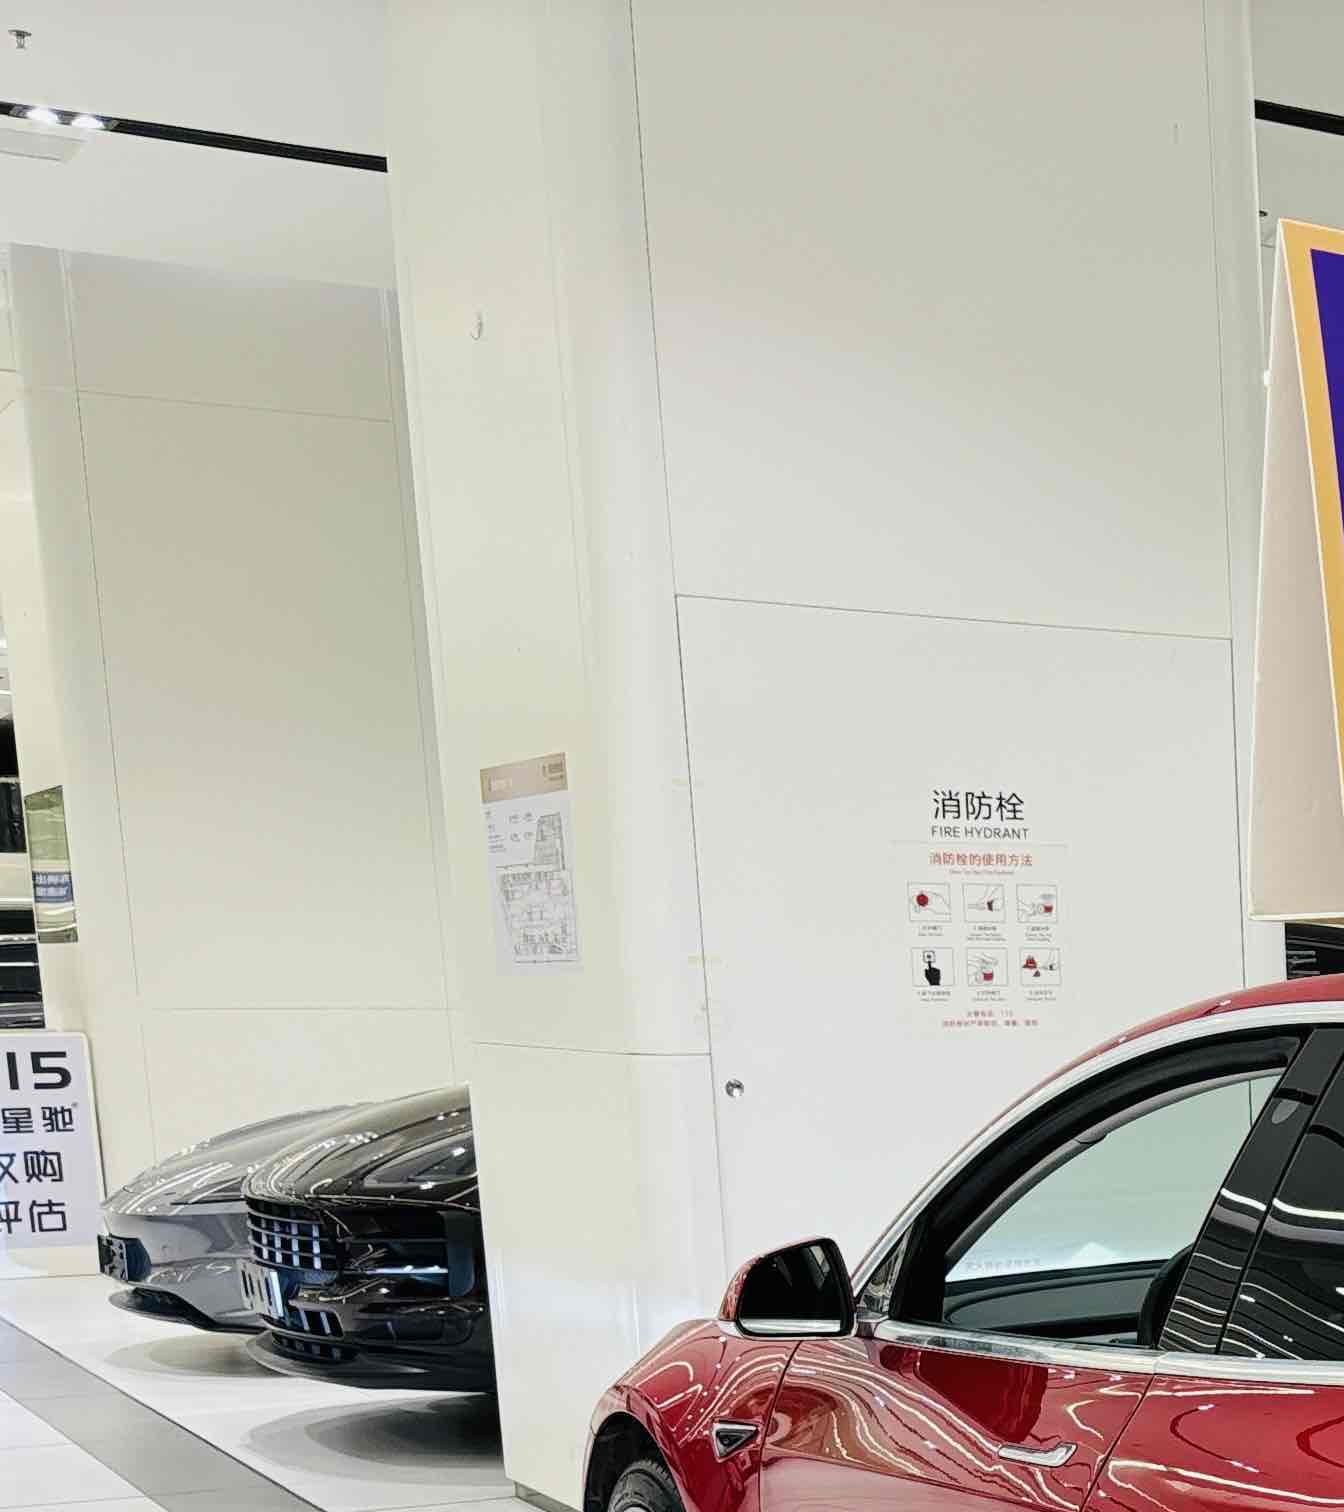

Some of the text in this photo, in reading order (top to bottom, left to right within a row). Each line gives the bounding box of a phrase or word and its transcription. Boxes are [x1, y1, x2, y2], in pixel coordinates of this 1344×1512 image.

[932, 789, 1025, 822] 消防栓
[931, 826, 1030, 840] FIRE HYDRANT
